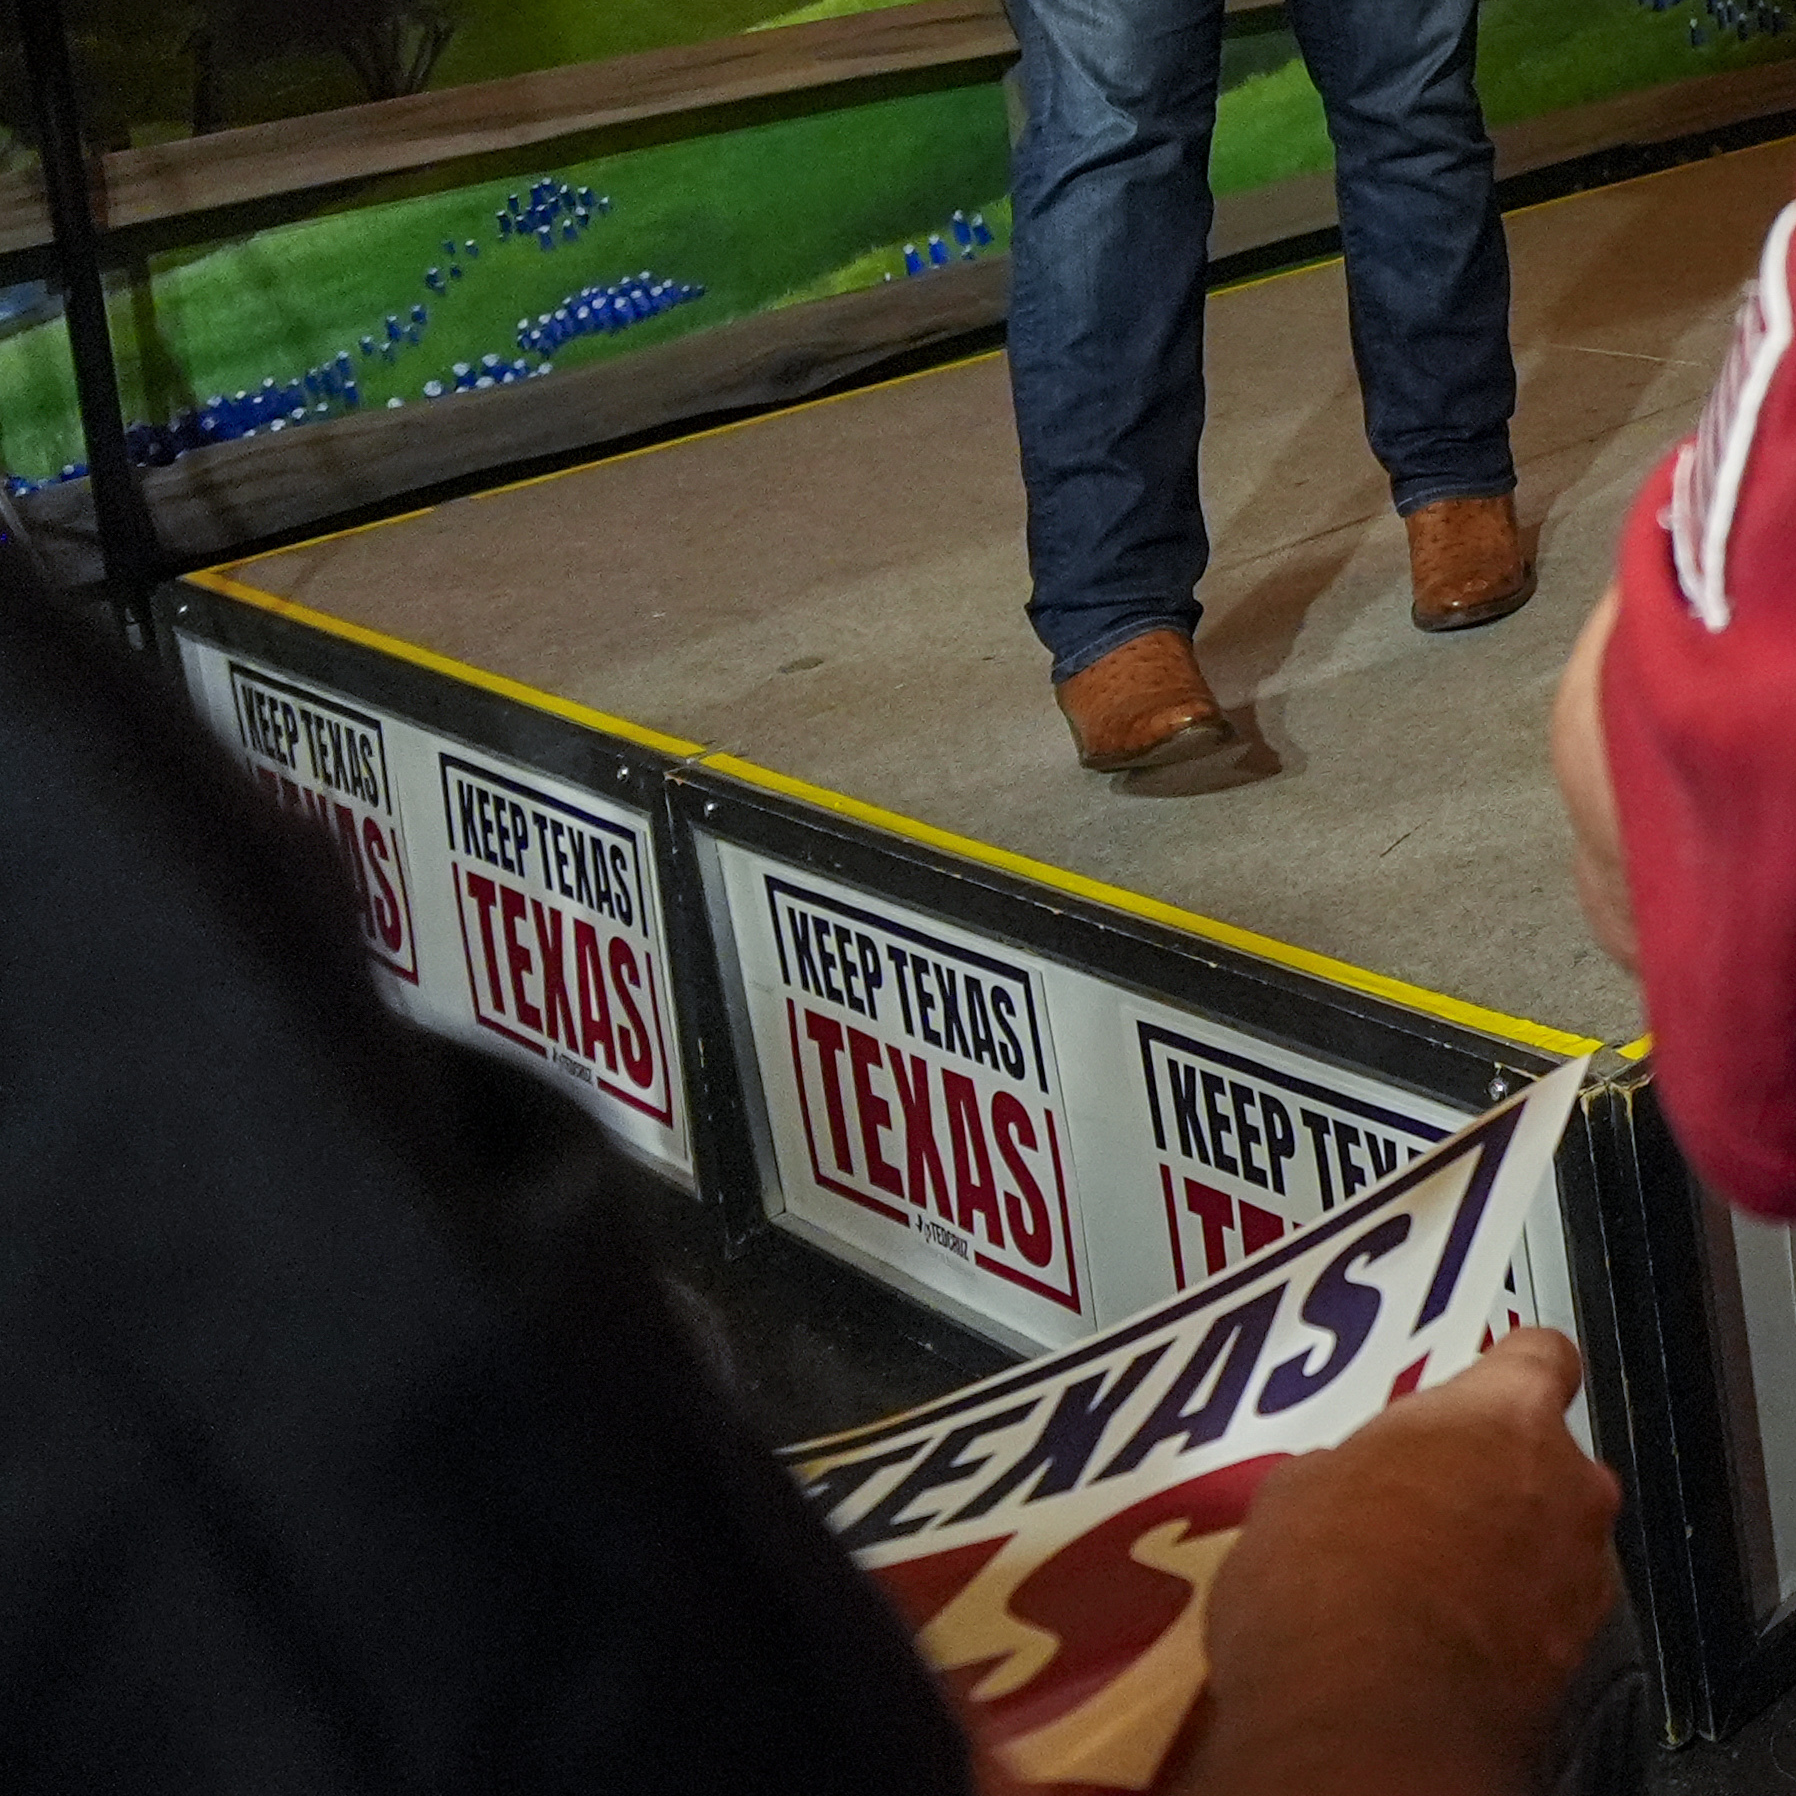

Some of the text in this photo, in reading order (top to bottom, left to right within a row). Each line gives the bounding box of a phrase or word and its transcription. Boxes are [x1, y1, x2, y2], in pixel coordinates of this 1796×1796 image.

[241, 684, 380, 809] KEEP TEXAS
[456, 779, 529, 878] KEEP
[532, 810, 634, 928] TEXAS
[466, 870, 654, 1090] TEXAS
[786, 905, 1026, 1081] KEEP TEXAS
[804, 1007, 1053, 1269] TEXAS
[1166, 1056, 1296, 1197] KEEP
[809, 1211, 1412, 1550] TEXAS
